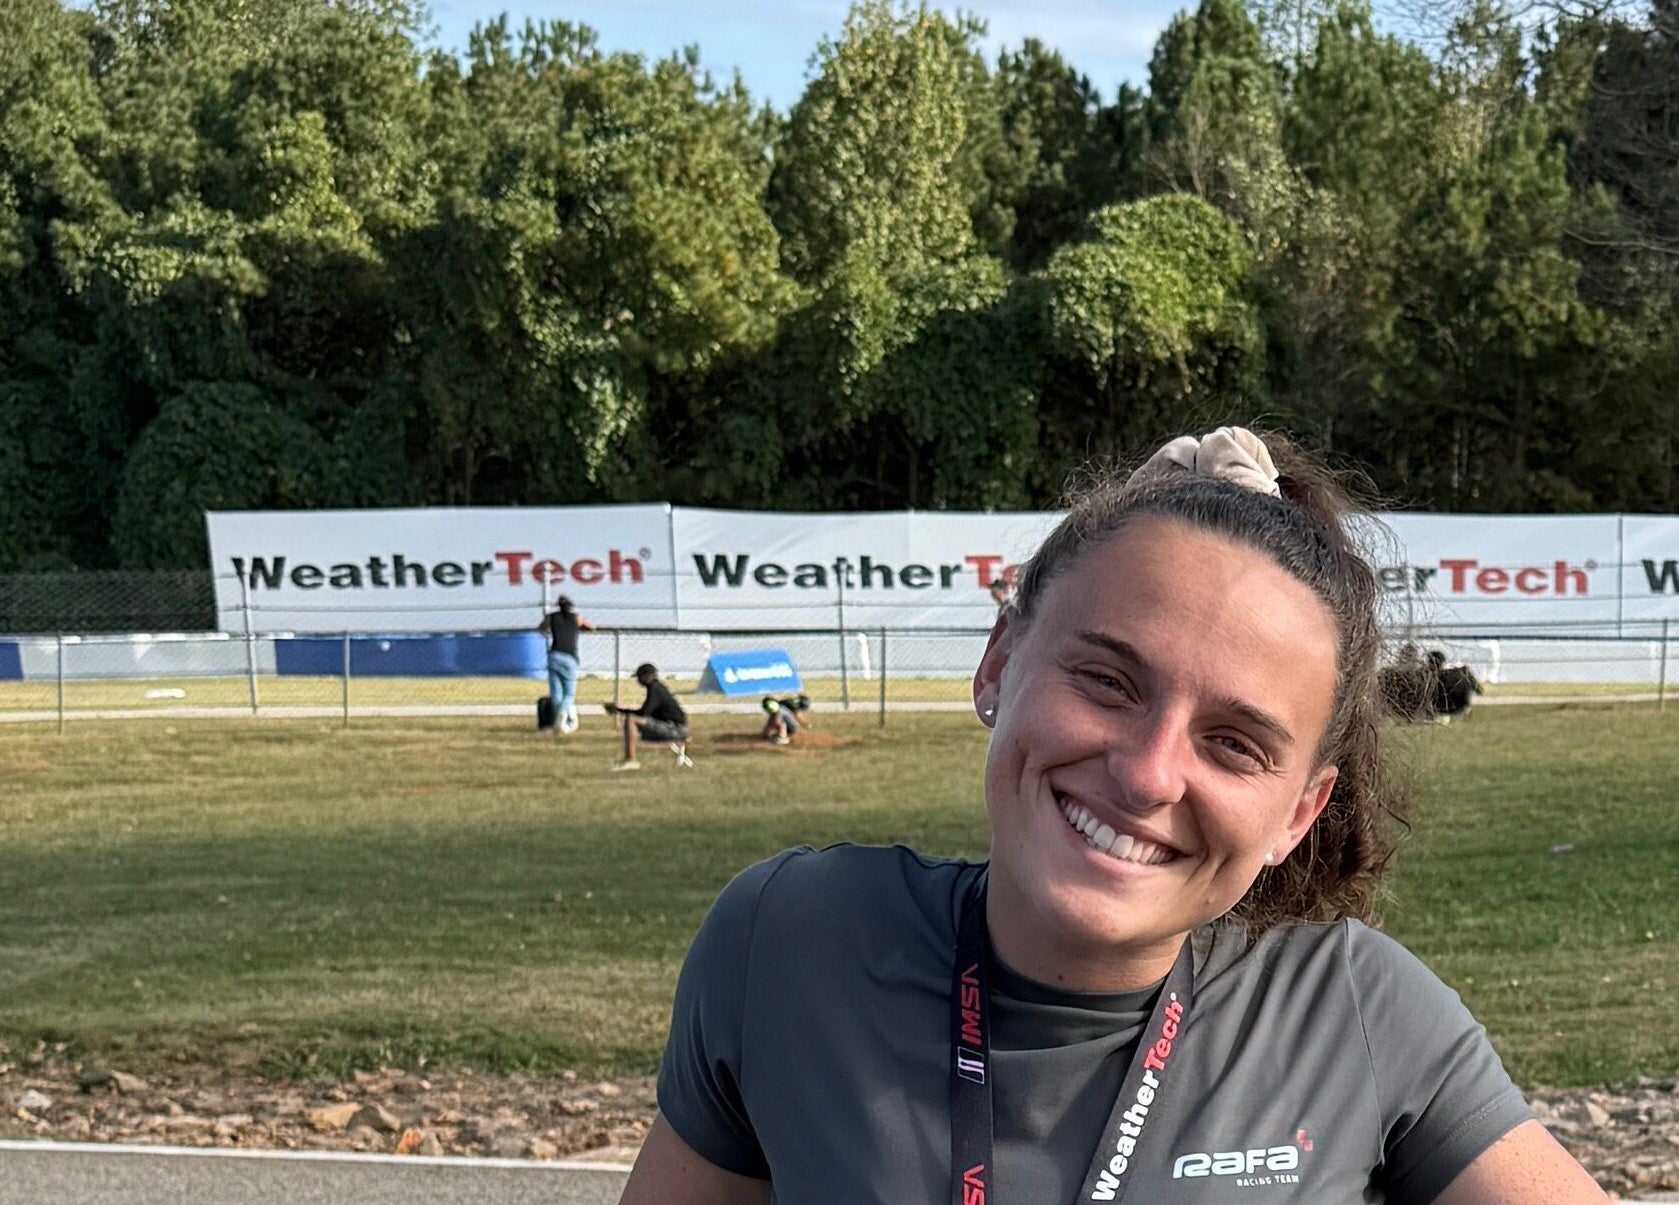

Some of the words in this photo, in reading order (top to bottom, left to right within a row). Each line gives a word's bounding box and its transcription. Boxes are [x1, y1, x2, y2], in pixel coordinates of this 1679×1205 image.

[961, 963, 982, 1046] IMSA
[1236, 1176, 1272, 1187] RACING
[1275, 1174, 1300, 1184] TEAM
